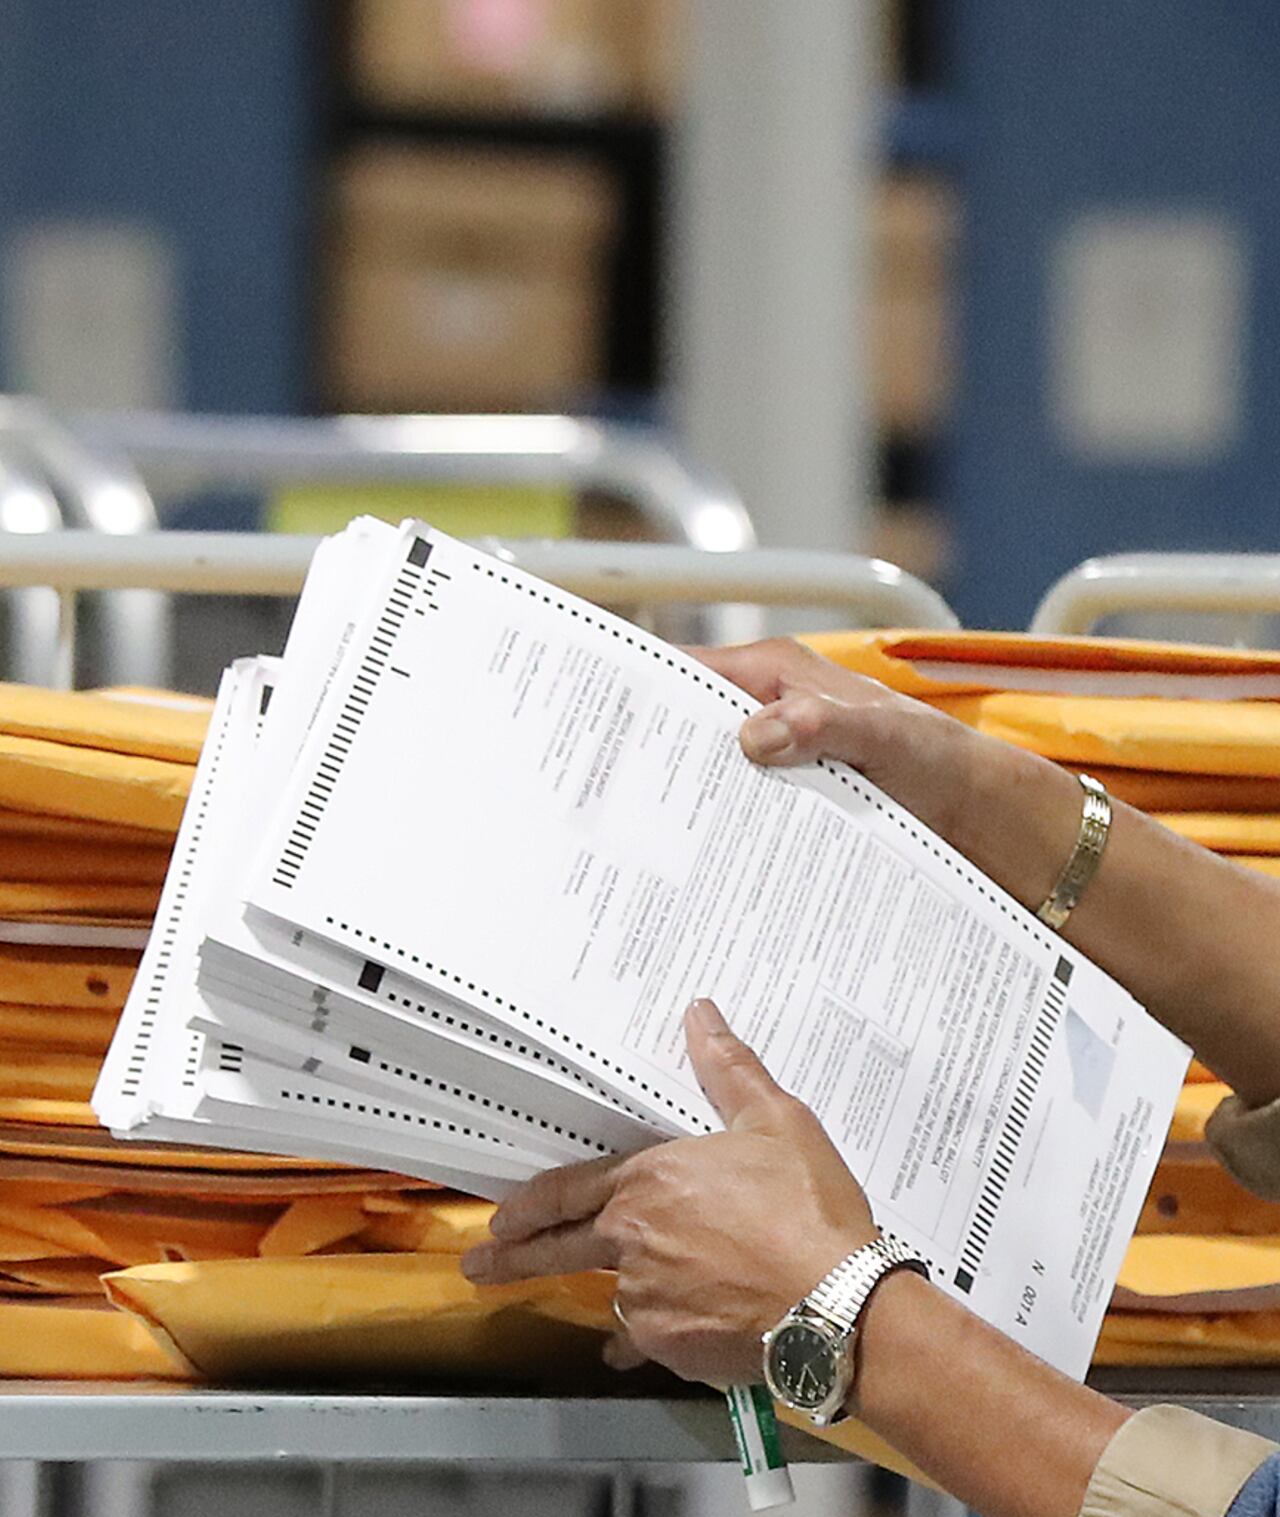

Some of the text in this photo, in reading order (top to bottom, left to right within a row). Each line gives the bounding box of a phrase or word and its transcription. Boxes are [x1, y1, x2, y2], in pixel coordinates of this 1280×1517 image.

[1014, 1258, 1046, 1327] N 001 A
